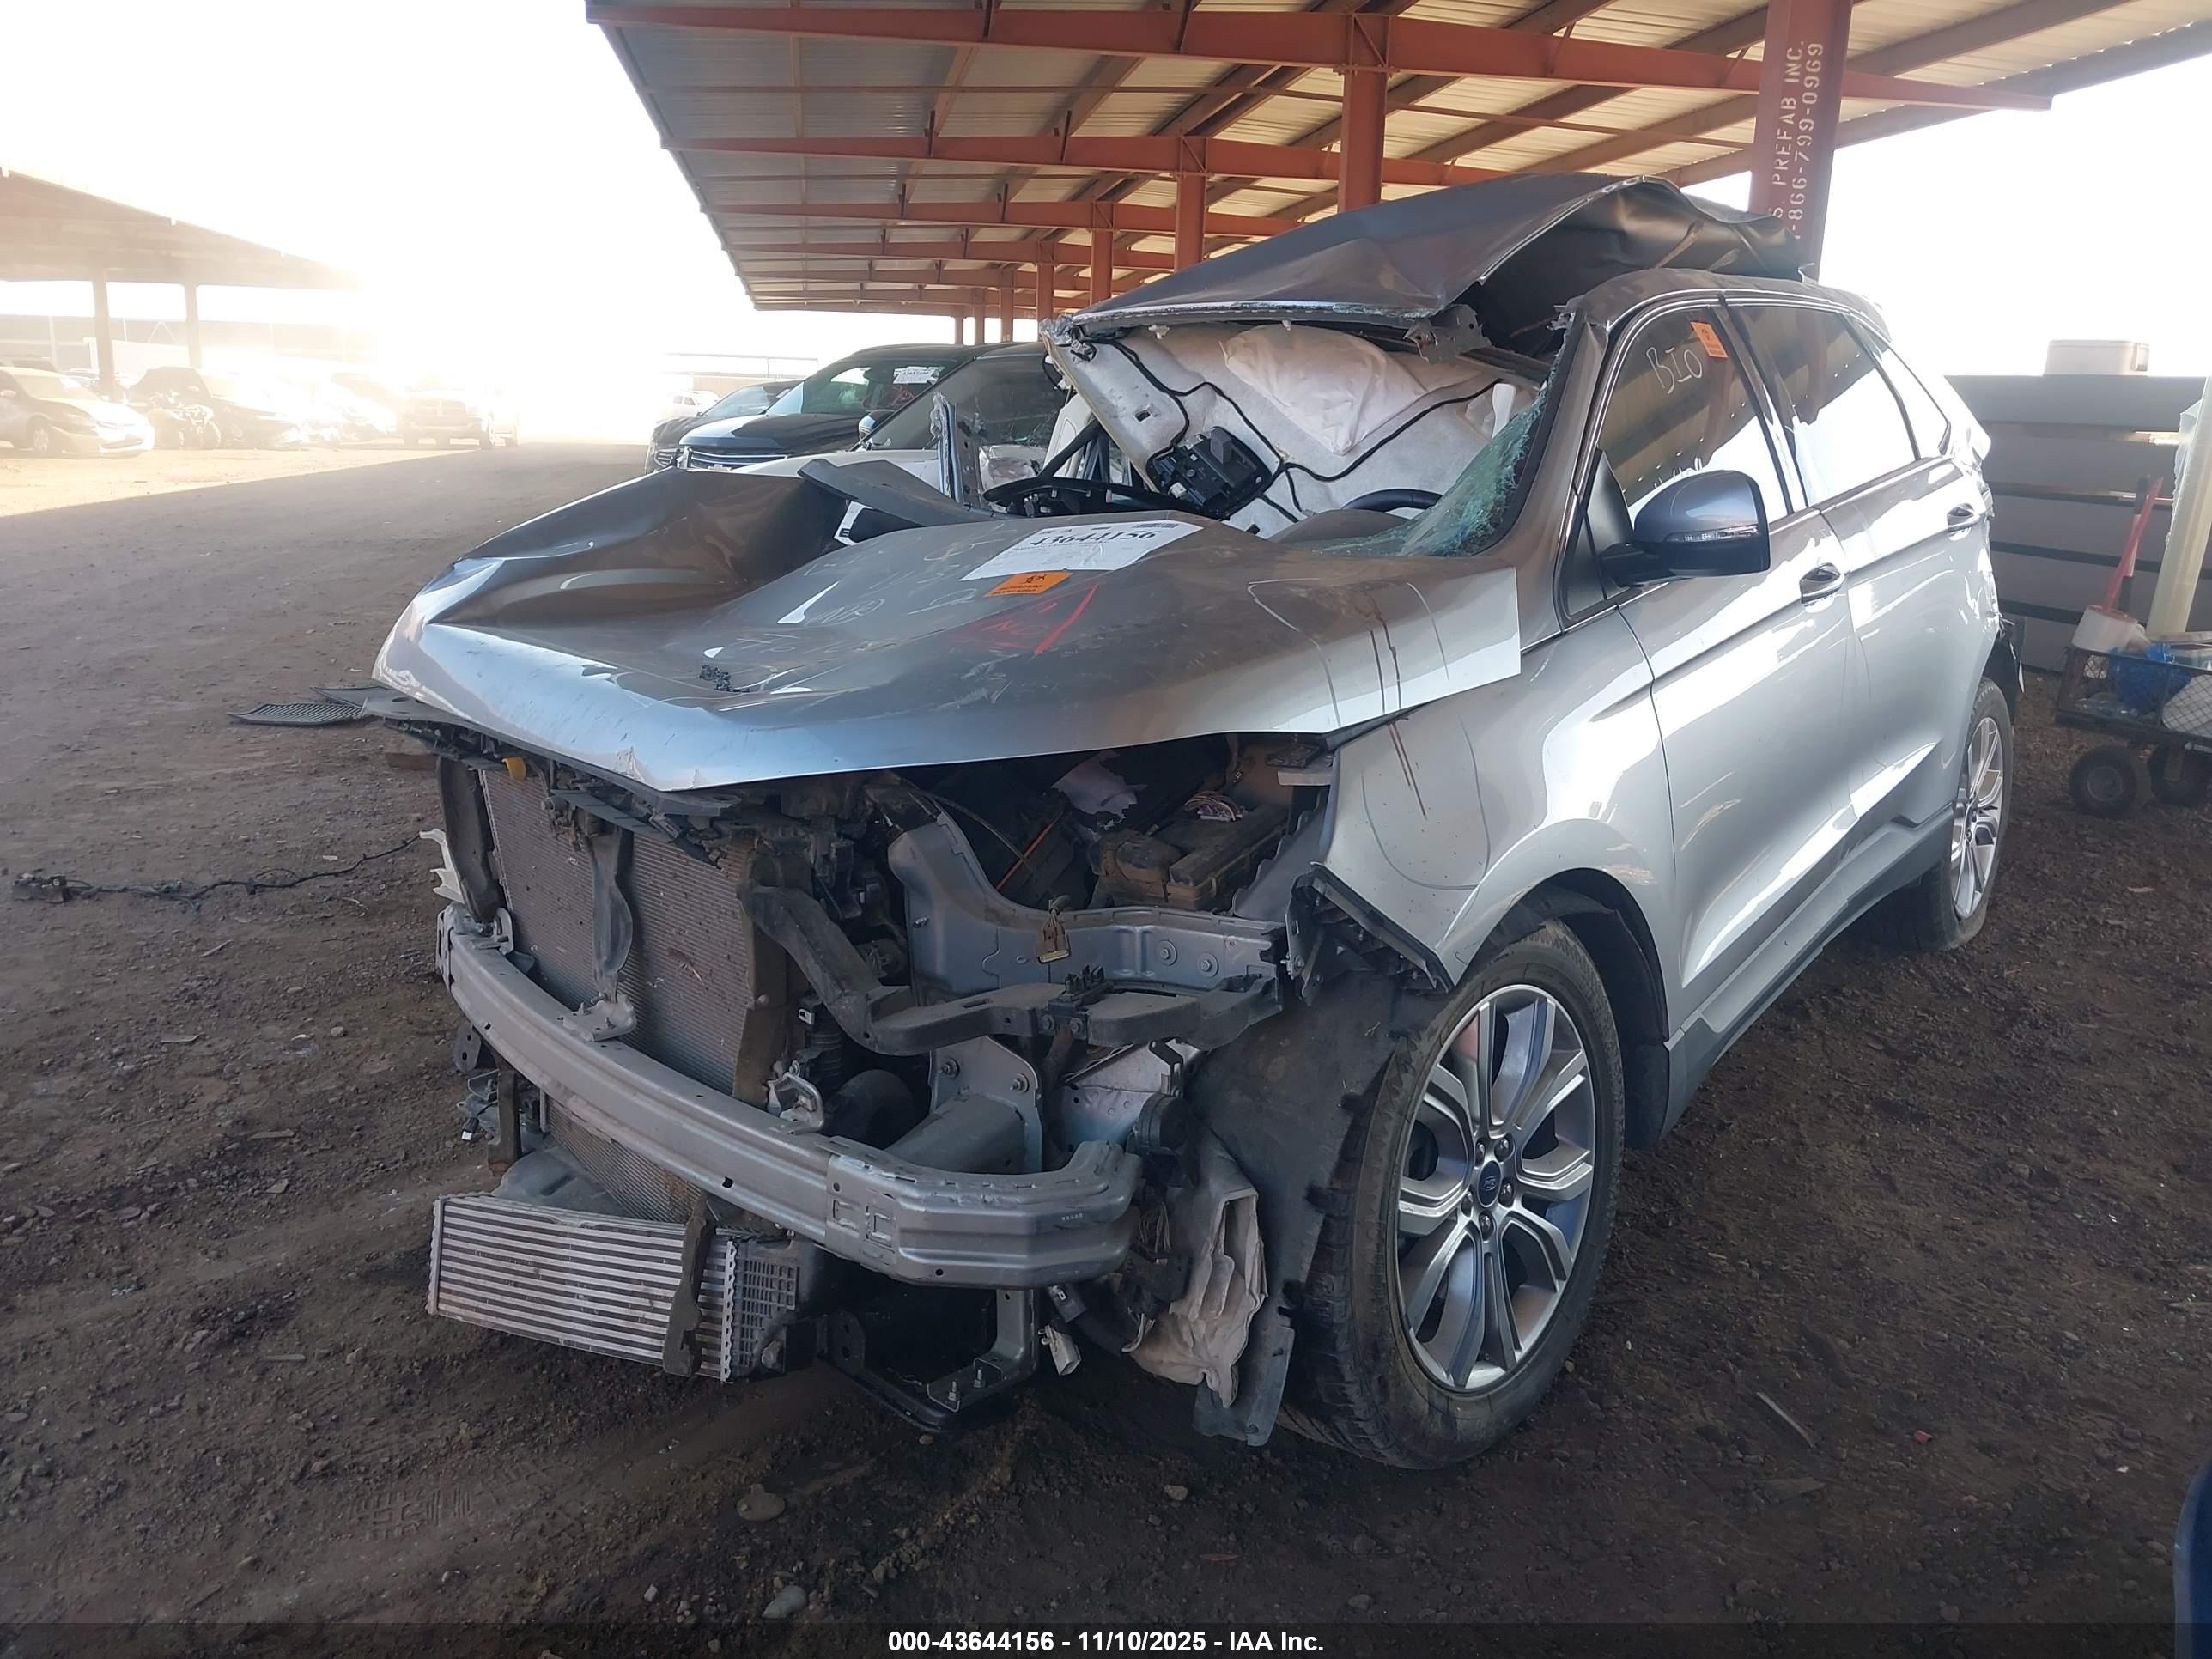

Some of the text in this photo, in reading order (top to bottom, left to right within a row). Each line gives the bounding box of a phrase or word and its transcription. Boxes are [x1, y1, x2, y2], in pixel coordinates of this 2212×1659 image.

[1784, 40, 1804, 84] INC.
[1772, 97, 1797, 185] PREFAB
[1646, 346, 1704, 395] BIO
[1030, 531, 1161, 546] 43644156
